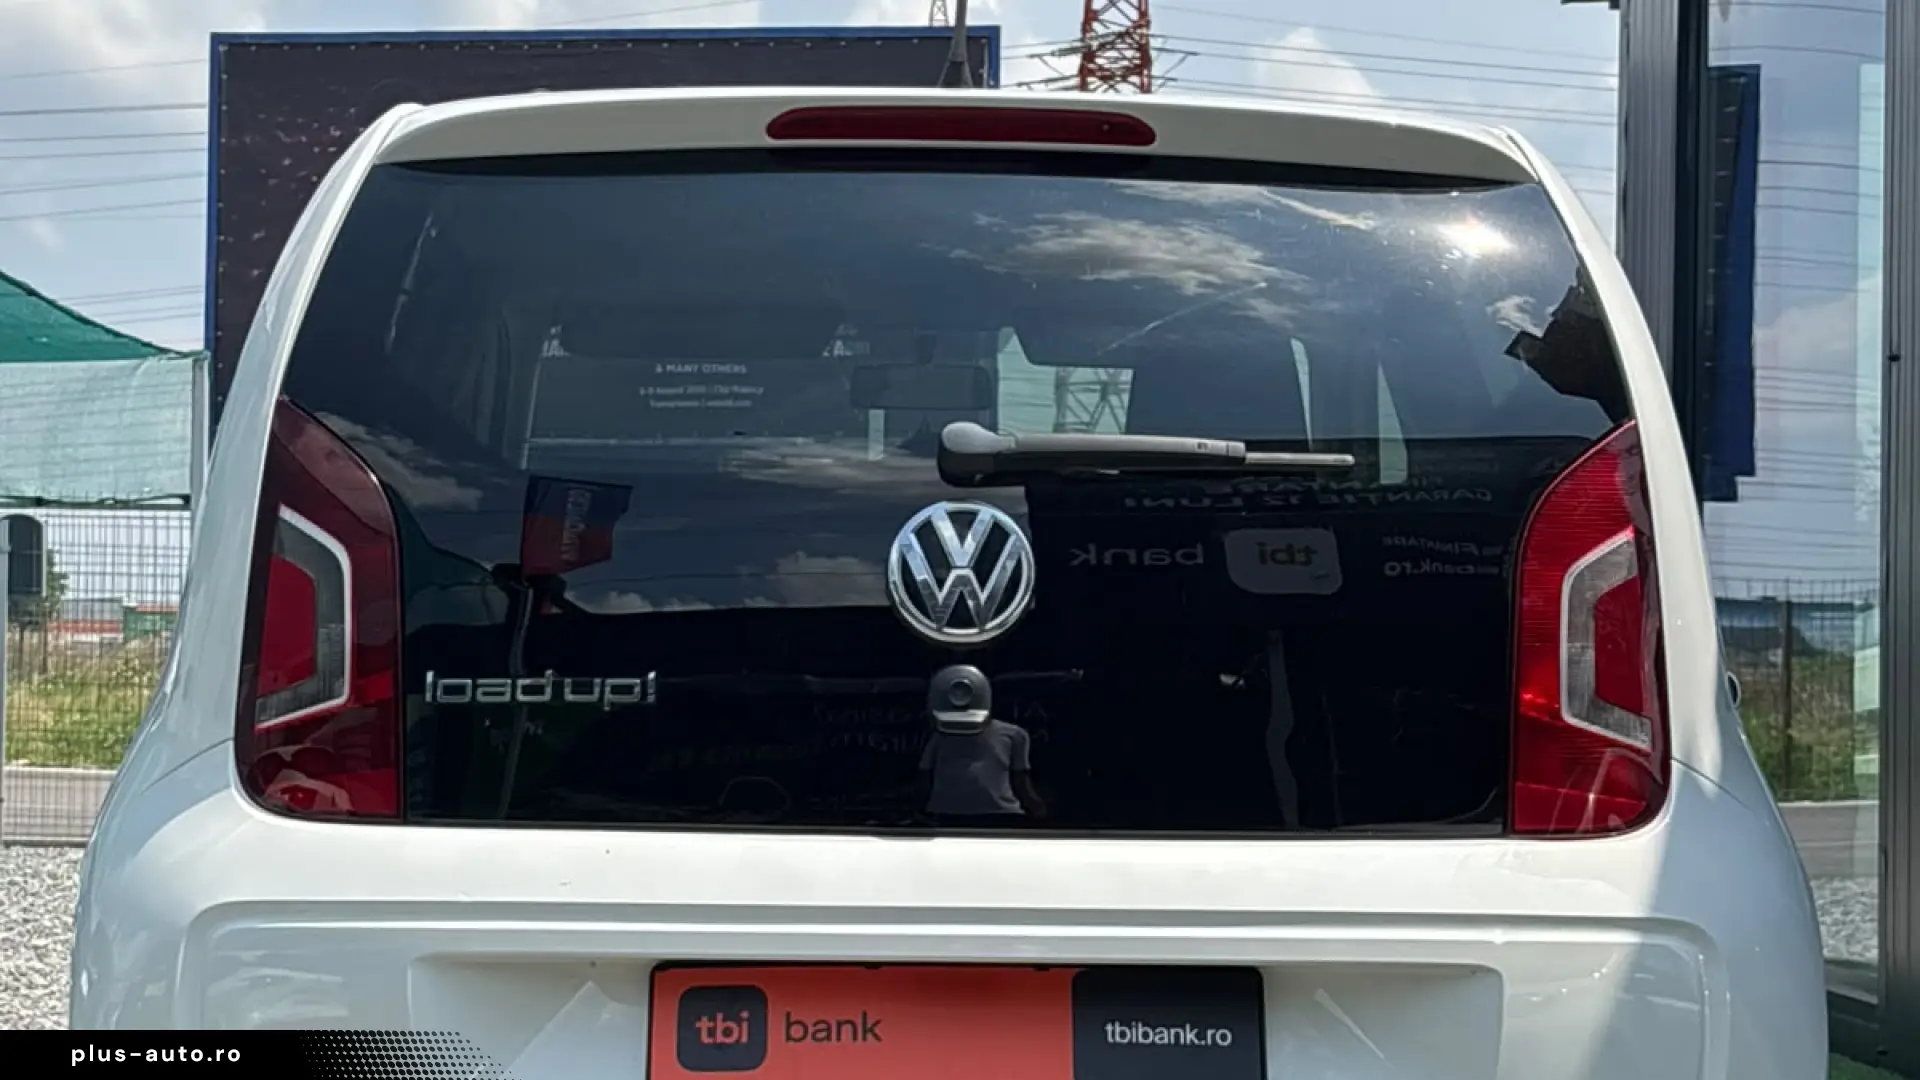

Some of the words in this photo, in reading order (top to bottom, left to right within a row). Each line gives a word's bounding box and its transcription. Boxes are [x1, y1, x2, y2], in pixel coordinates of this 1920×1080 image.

[666, 363, 699, 374] MANY
[702, 363, 748, 374] OTHERS
[425, 669, 554, 704] load
[564, 669, 657, 712] up!
[695, 1010, 750, 1044] tbi
[784, 1010, 883, 1043] bank
[1104, 1021, 1233, 1049] tbibank.ro
